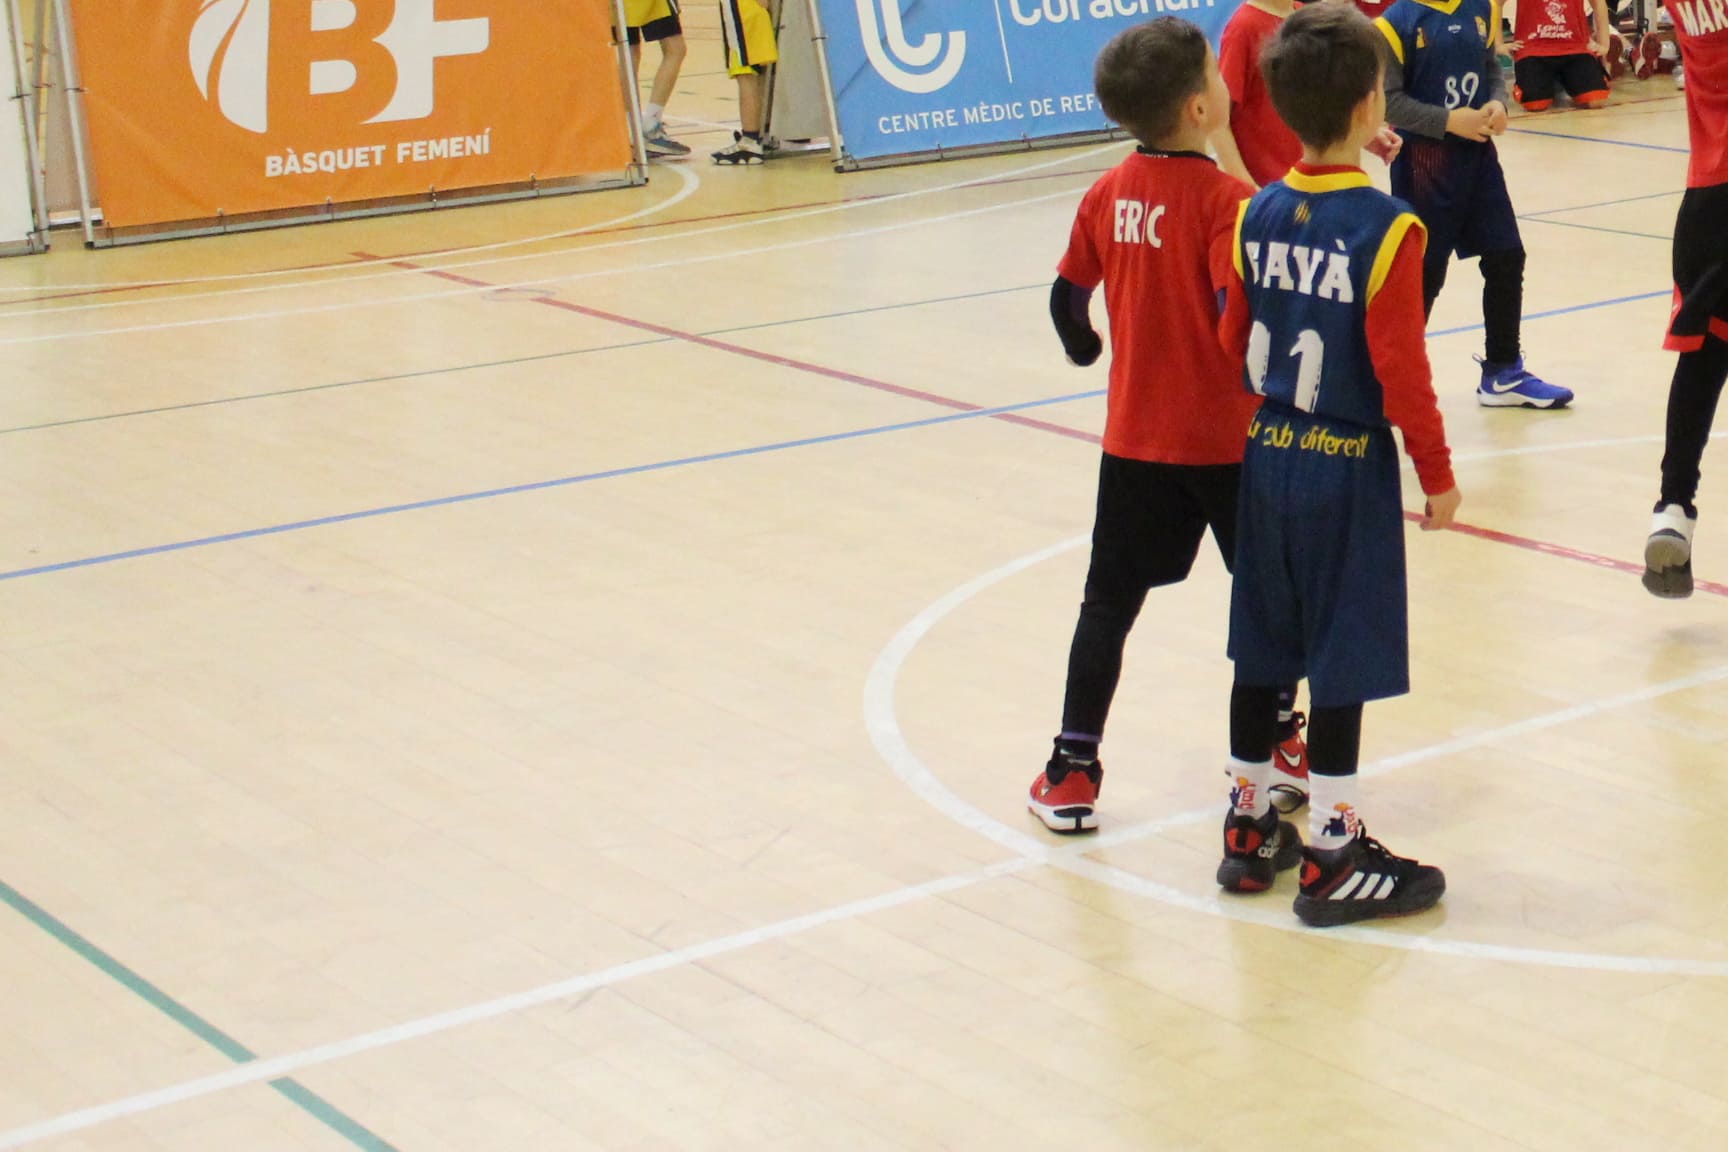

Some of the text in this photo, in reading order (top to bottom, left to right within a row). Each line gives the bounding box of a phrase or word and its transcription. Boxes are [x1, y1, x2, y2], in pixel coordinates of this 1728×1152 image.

[1444, 71, 1480, 110] 89
[878, 93, 1103, 134] CENTRE MÈDIC DE REF
[265, 127, 491, 178] BÀSQUET FEMENÍ
[1113, 199, 1166, 249] ERIC
